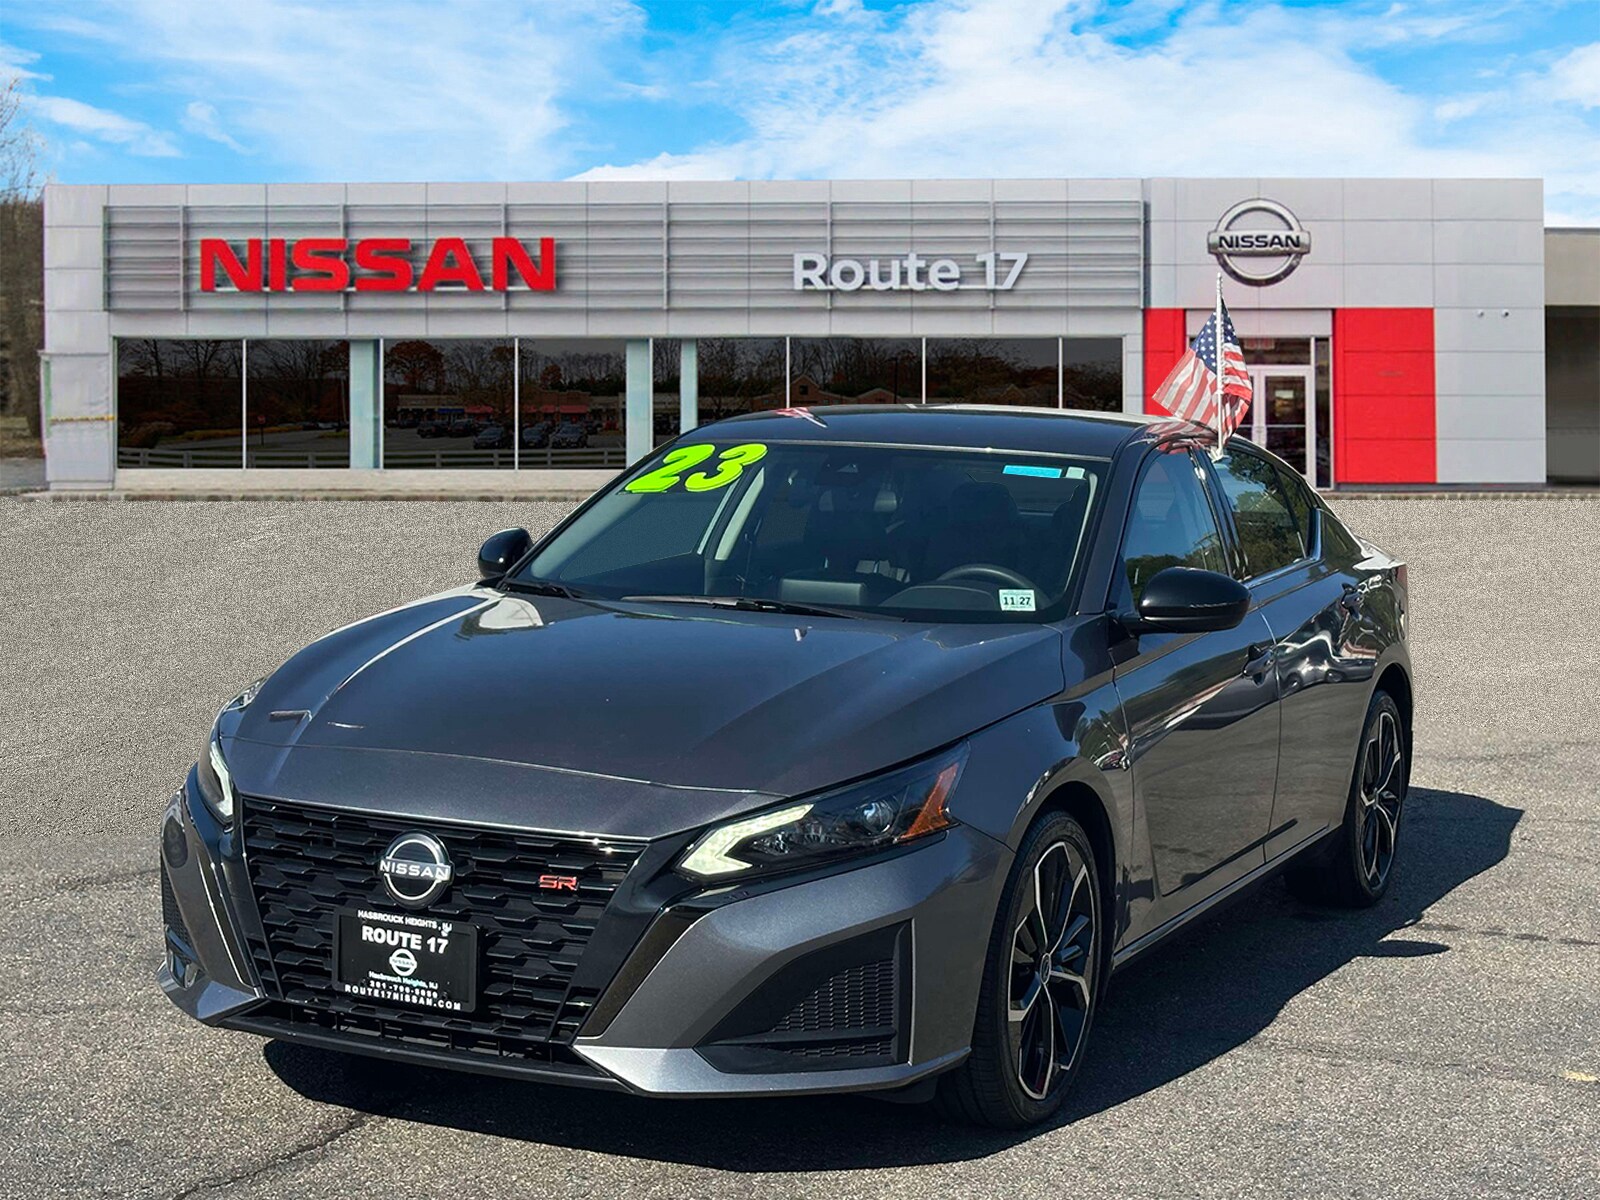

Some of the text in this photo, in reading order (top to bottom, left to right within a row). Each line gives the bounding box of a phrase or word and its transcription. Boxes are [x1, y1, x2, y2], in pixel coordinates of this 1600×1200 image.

[1219, 235, 1300, 249] NISSAN
[200, 237, 557, 292] NISSAN
[793, 252, 1028, 291] Route 17
[624, 443, 768, 494] 23
[1019, 596, 1031, 606] 27
[379, 860, 450, 879] NISSAN
[539, 874, 577, 891] SR
[357, 909, 404, 925] HASBROUCK
[361, 924, 449, 954] ROUTE 17
[344, 984, 461, 1011] ROUTE17NISSAN.COM
